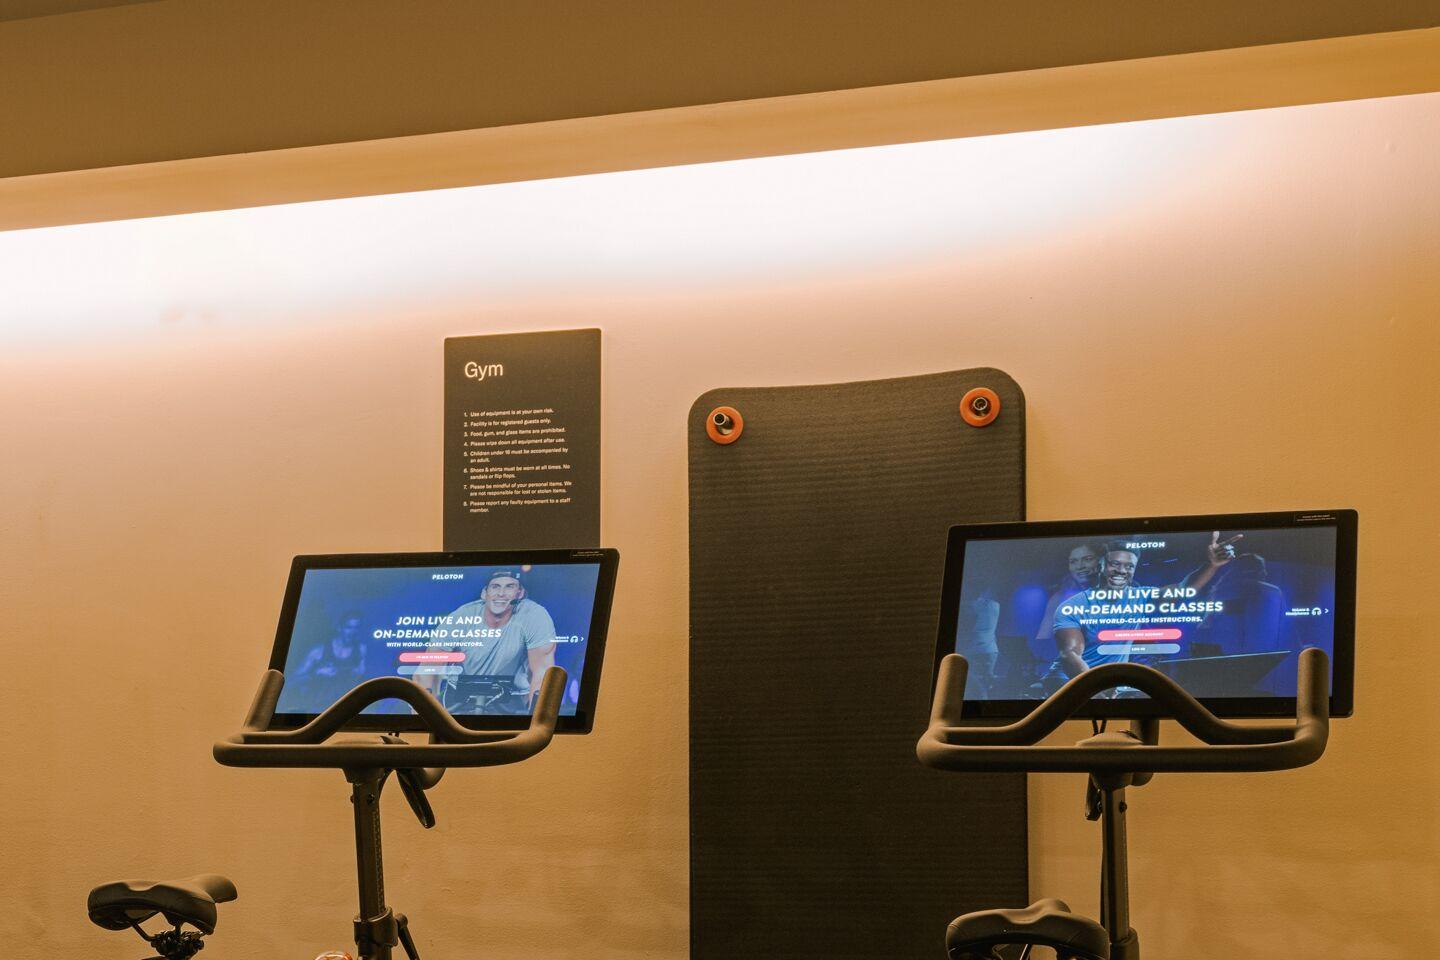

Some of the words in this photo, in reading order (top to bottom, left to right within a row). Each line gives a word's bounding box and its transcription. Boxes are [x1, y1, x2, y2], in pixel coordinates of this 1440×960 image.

[465, 361, 503, 381] Gym
[1088, 590, 1123, 600] JOIN
[1128, 589, 1160, 599] LIVE
[1163, 588, 1197, 598] AND
[1062, 603, 1155, 615] ON-DEMAND
[1159, 601, 1223, 613] CLASSES
[396, 616, 425, 625] JOIN
[428, 616, 453, 625] LIVE
[456, 616, 482, 625] AND
[373, 629, 448, 639] ON-DEMAND
[451, 629, 502, 638] CLASSES
